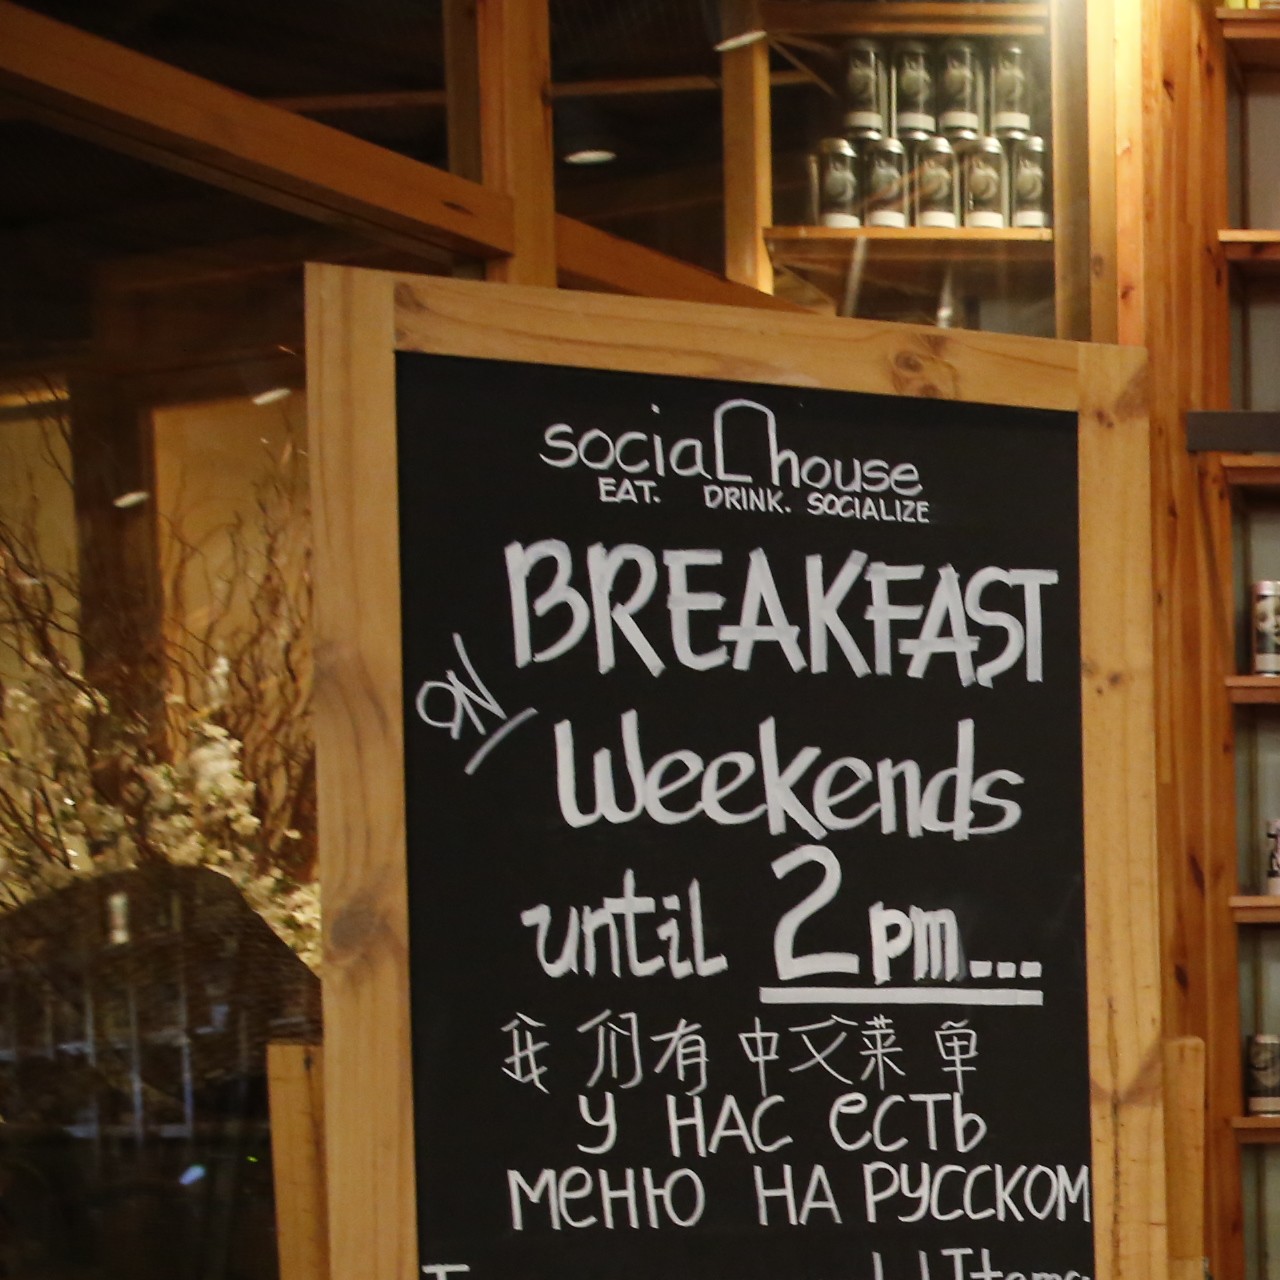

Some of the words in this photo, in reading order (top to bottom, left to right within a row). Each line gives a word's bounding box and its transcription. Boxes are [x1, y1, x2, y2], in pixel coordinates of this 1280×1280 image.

[539, 399, 753, 483] social
[766, 402, 924, 496] house
[598, 476, 661, 505] EAT.
[703, 484, 792, 515] DRINK.
[806, 491, 931, 524] SOCIALIZE
[504, 537, 1059, 687] BREAKFAST
[416, 633, 506, 739] ON
[553, 708, 1025, 840] Weekends
[520, 867, 728, 979] until
[770, 843, 860, 980] 2
